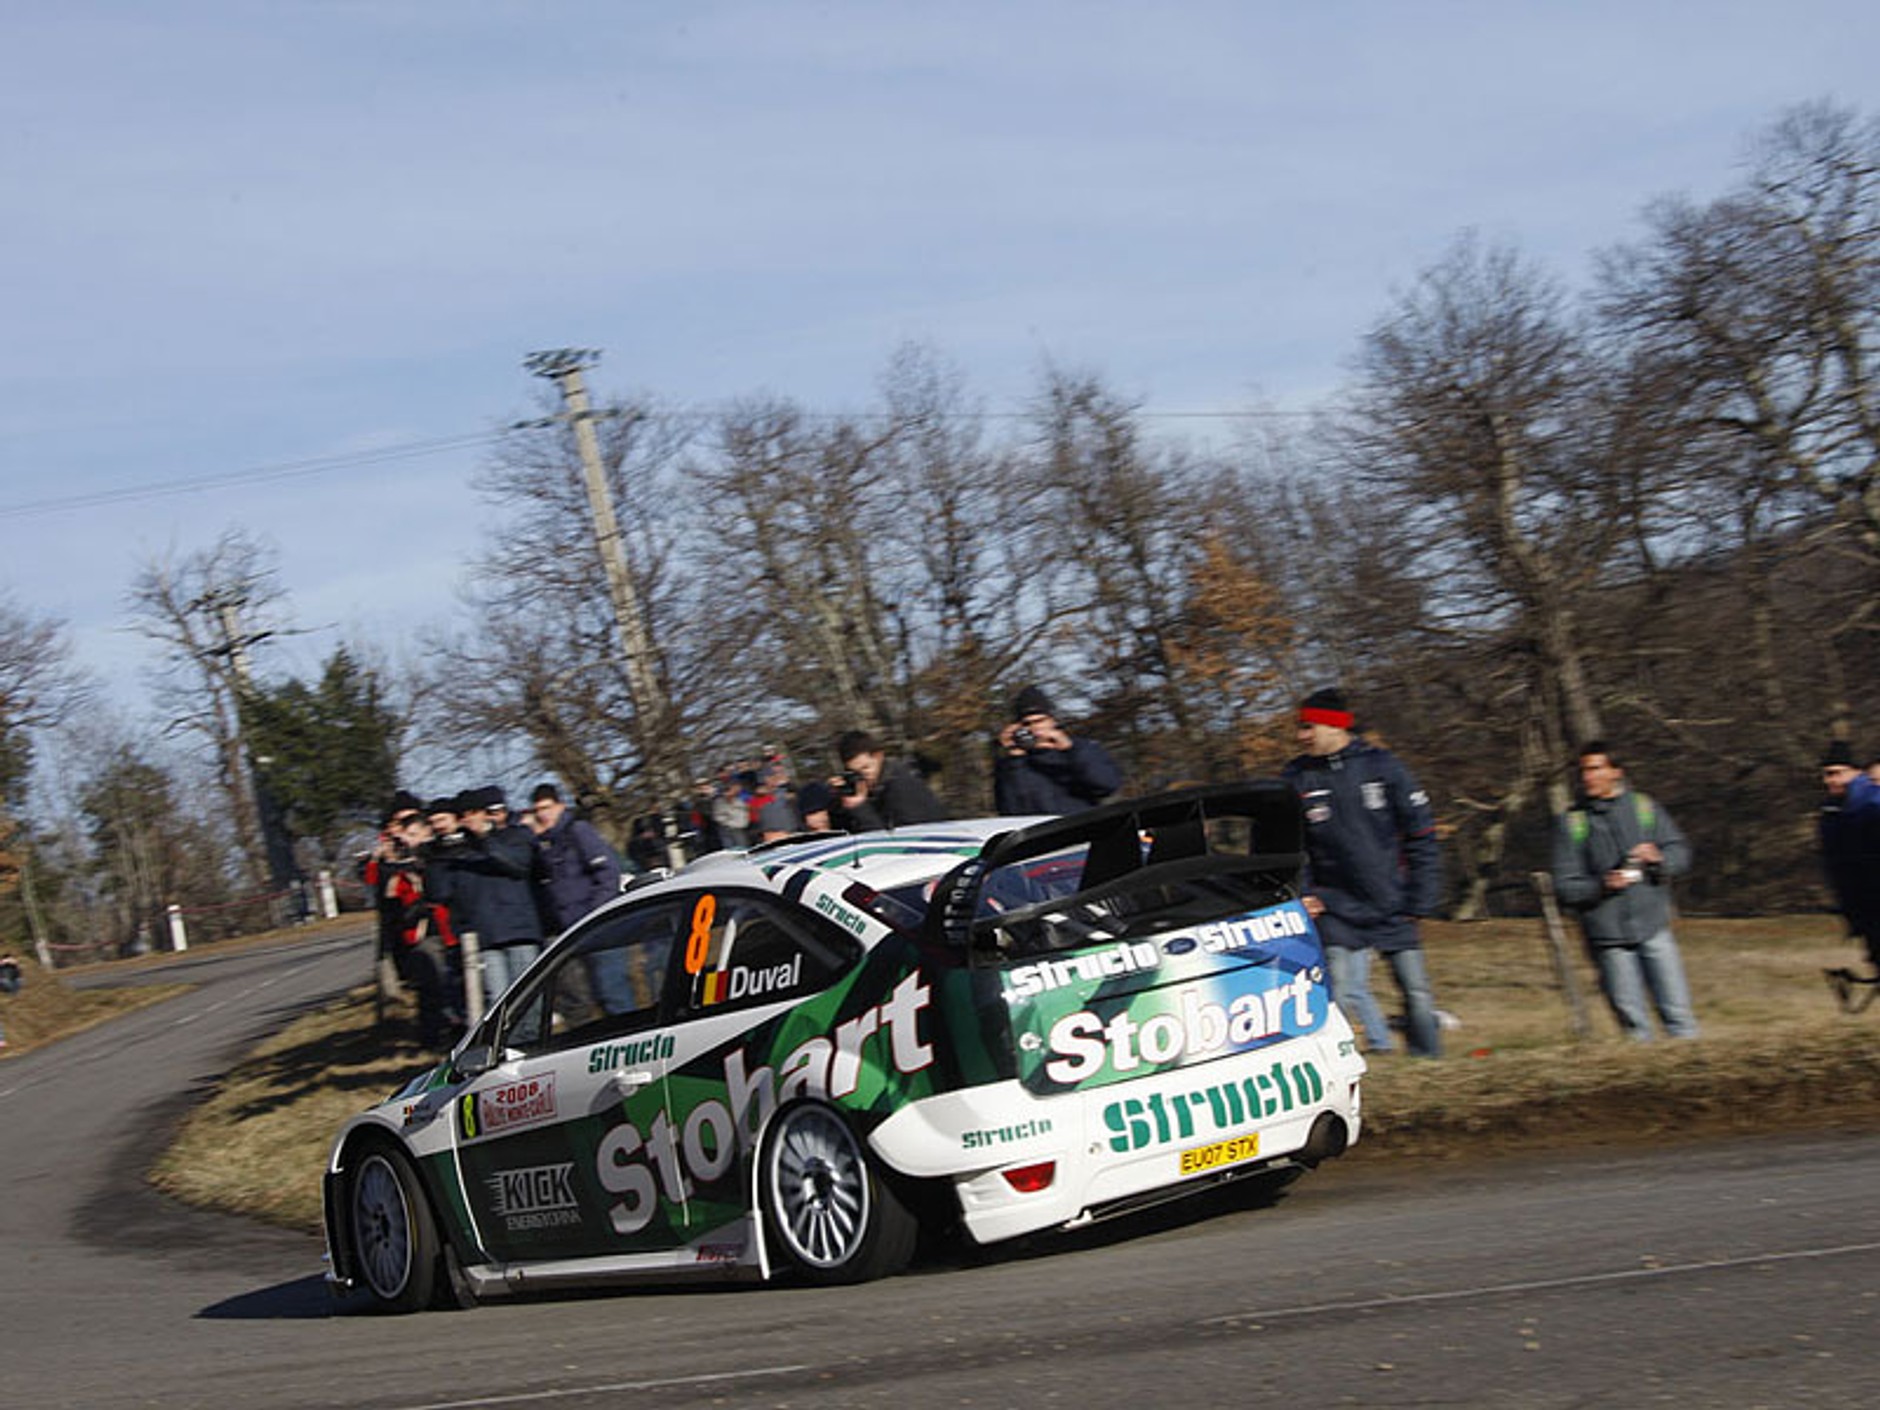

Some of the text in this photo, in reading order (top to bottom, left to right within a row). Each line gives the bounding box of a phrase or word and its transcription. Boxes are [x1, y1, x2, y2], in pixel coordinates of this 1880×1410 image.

[685, 894, 717, 974] 8
[815, 893, 867, 935] Structo
[1208, 910, 1307, 953] Structo
[729, 953, 802, 999] Duval
[1010, 942, 1159, 998] Structo
[1046, 966, 1314, 1084] Stobart
[588, 1034, 675, 1073] Structo
[463, 1093, 476, 1137] 8
[597, 970, 935, 1235] Stobart
[1102, 1061, 1325, 1153] Structo
[962, 1119, 1051, 1149] Structo
[1182, 1134, 1258, 1171] EU07 STX
